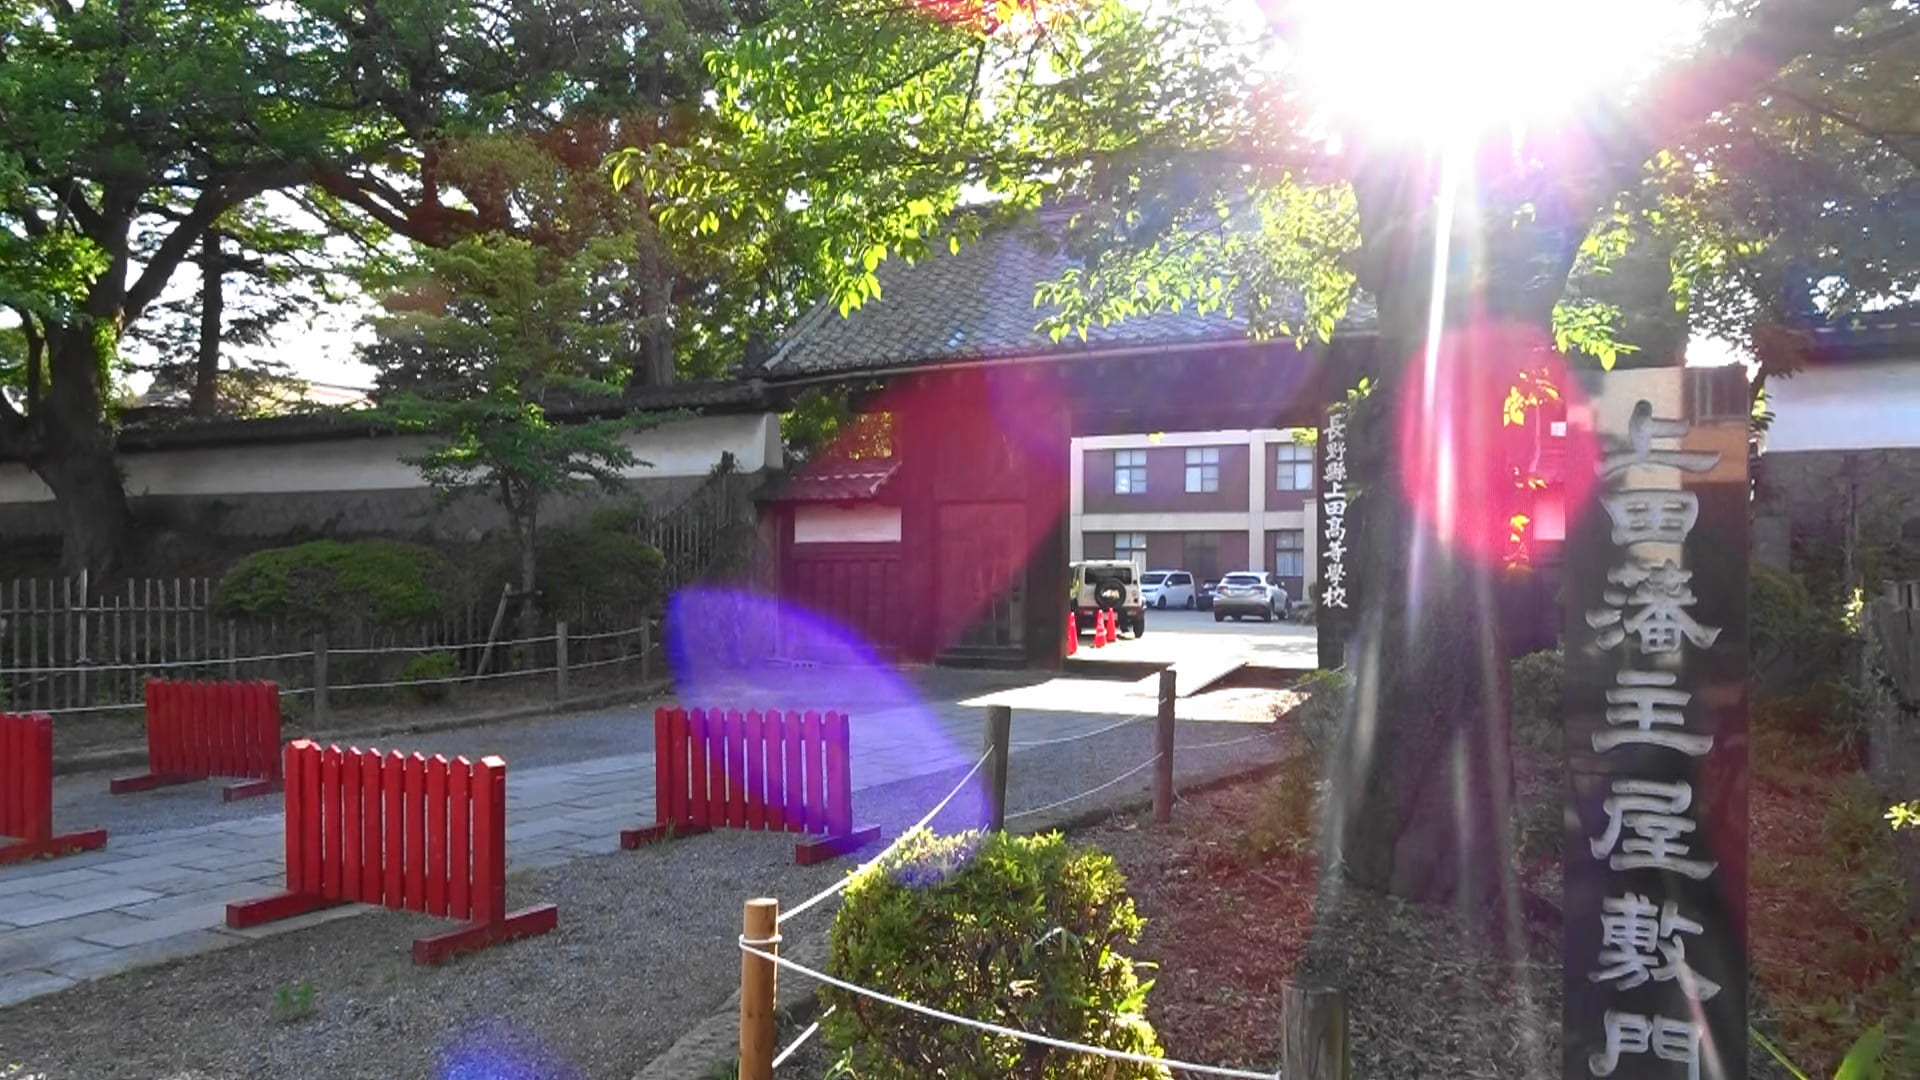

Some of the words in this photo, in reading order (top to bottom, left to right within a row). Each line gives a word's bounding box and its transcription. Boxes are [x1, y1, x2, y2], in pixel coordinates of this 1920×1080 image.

[1585, 398, 1722, 1080] 上田藩主屋敷門
